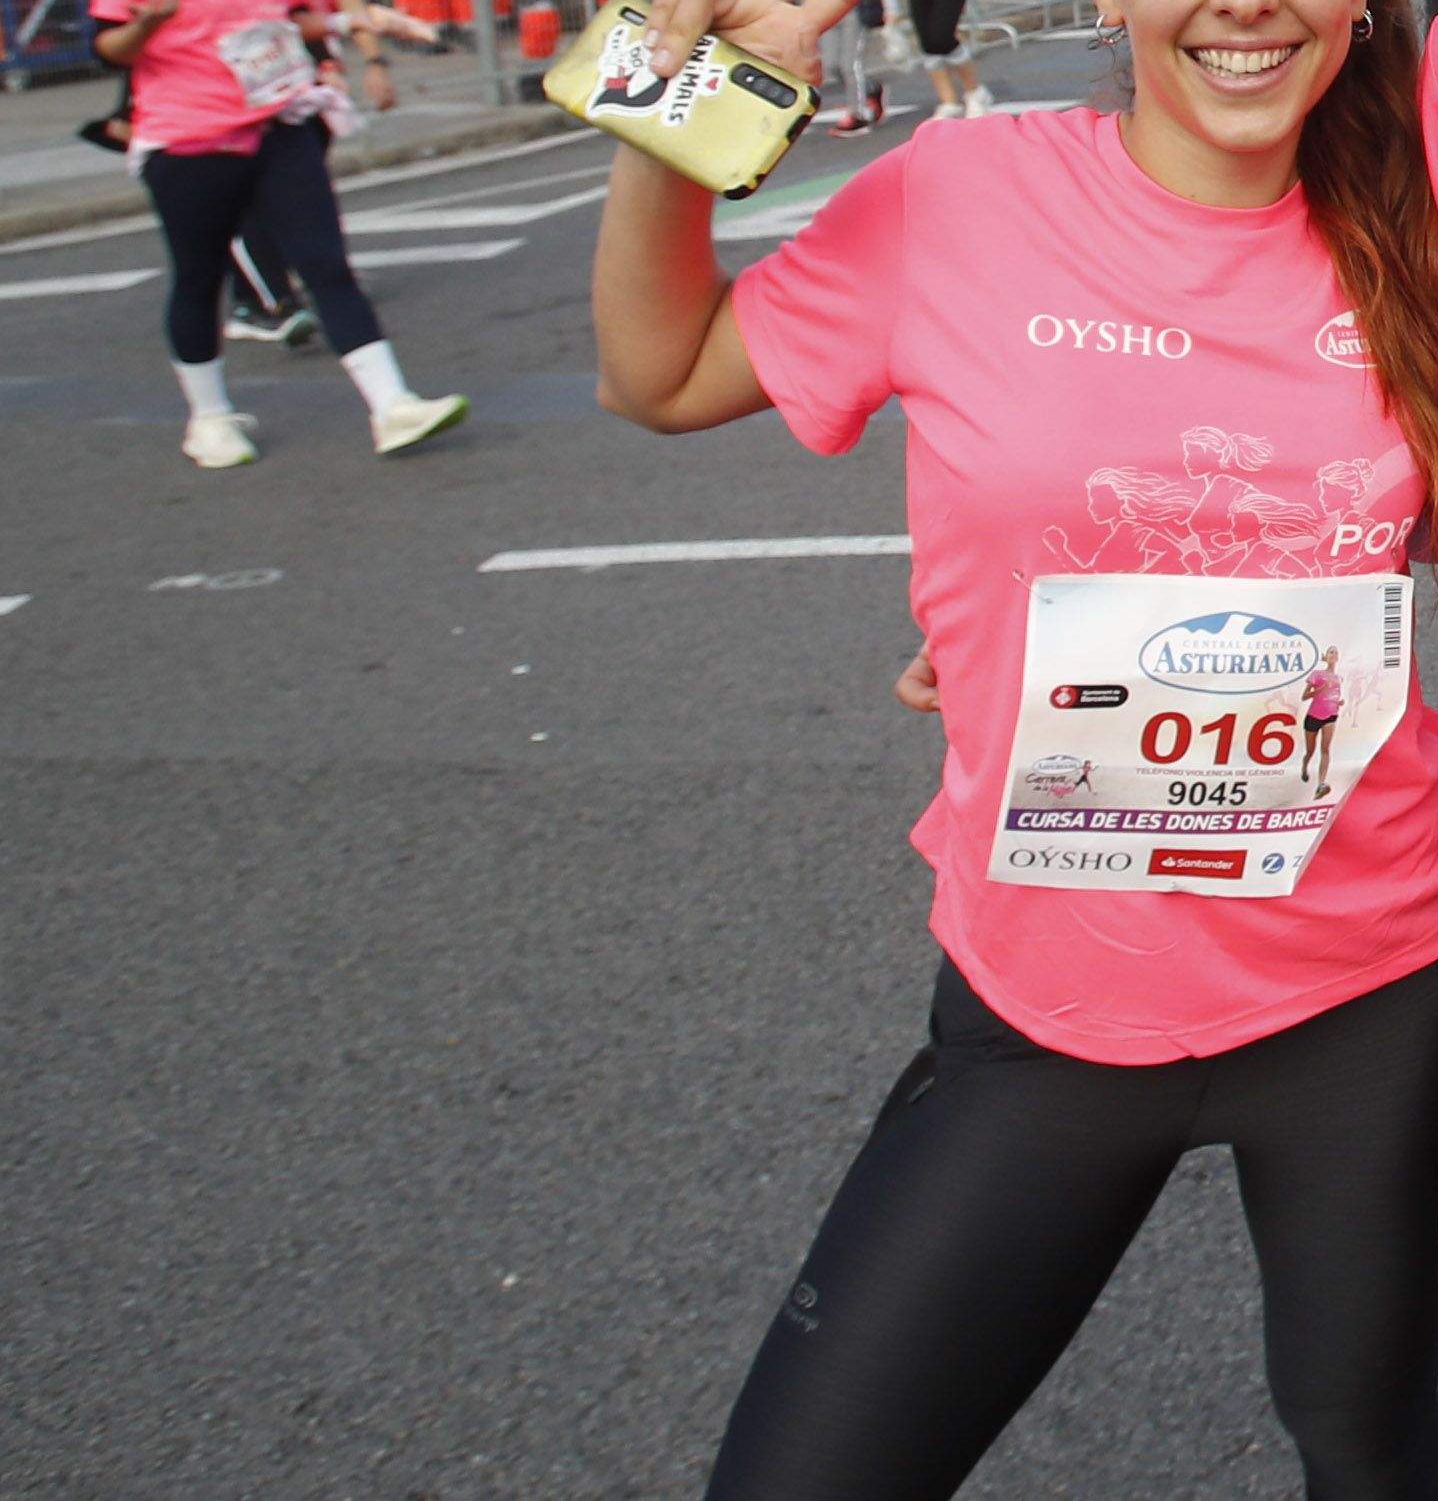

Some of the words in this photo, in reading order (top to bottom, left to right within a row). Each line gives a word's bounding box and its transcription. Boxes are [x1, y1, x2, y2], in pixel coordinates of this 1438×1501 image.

[1027, 314, 1192, 360] OYSHO
[1152, 641, 1306, 675] ASTURIANA
[1140, 711, 1296, 766] 016
[1167, 780, 1248, 807] 9045
[1017, 810, 1085, 830] CURSA
[1090, 811, 1122, 830] DE
[1124, 810, 1161, 831] LES
[1164, 813, 1233, 832] DONES
[1236, 812, 1262, 830] DE
[1266, 807, 1332, 829] BARCE
[1008, 846, 1133, 873] OYSHO
[1175, 856, 1235, 872] Santander
